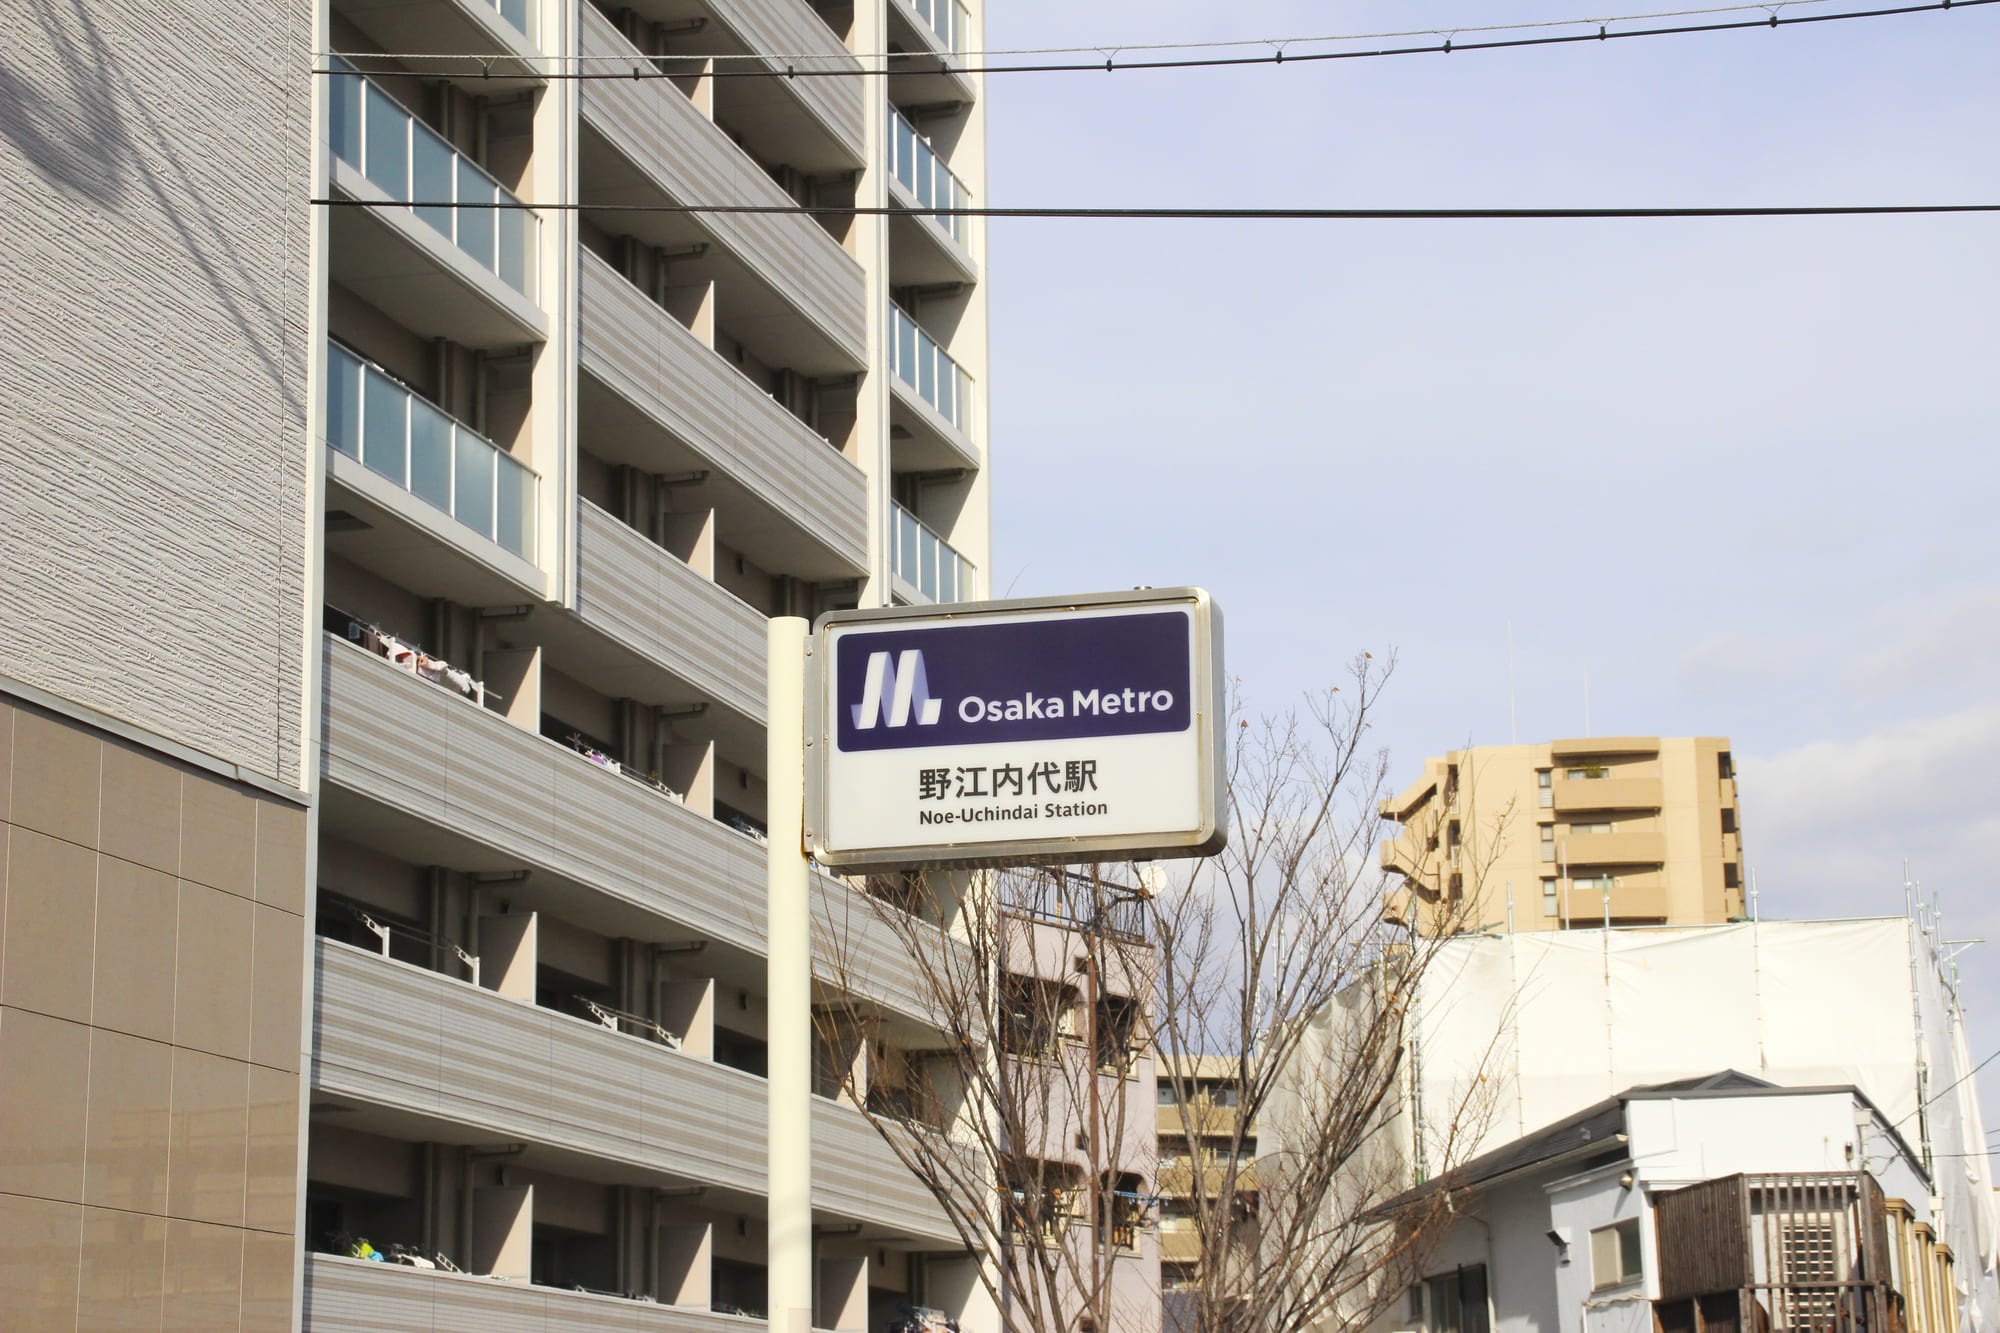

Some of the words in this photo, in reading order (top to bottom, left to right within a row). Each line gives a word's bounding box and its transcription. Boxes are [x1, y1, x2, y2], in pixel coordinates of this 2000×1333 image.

[958, 691, 1065, 723] Osaka
[1072, 687, 1174, 717] Metro
[919, 759, 1098, 800] 野江内代駅
[919, 803, 1038, 825] Noe-Uchindai
[1044, 801, 1108, 818] Station
